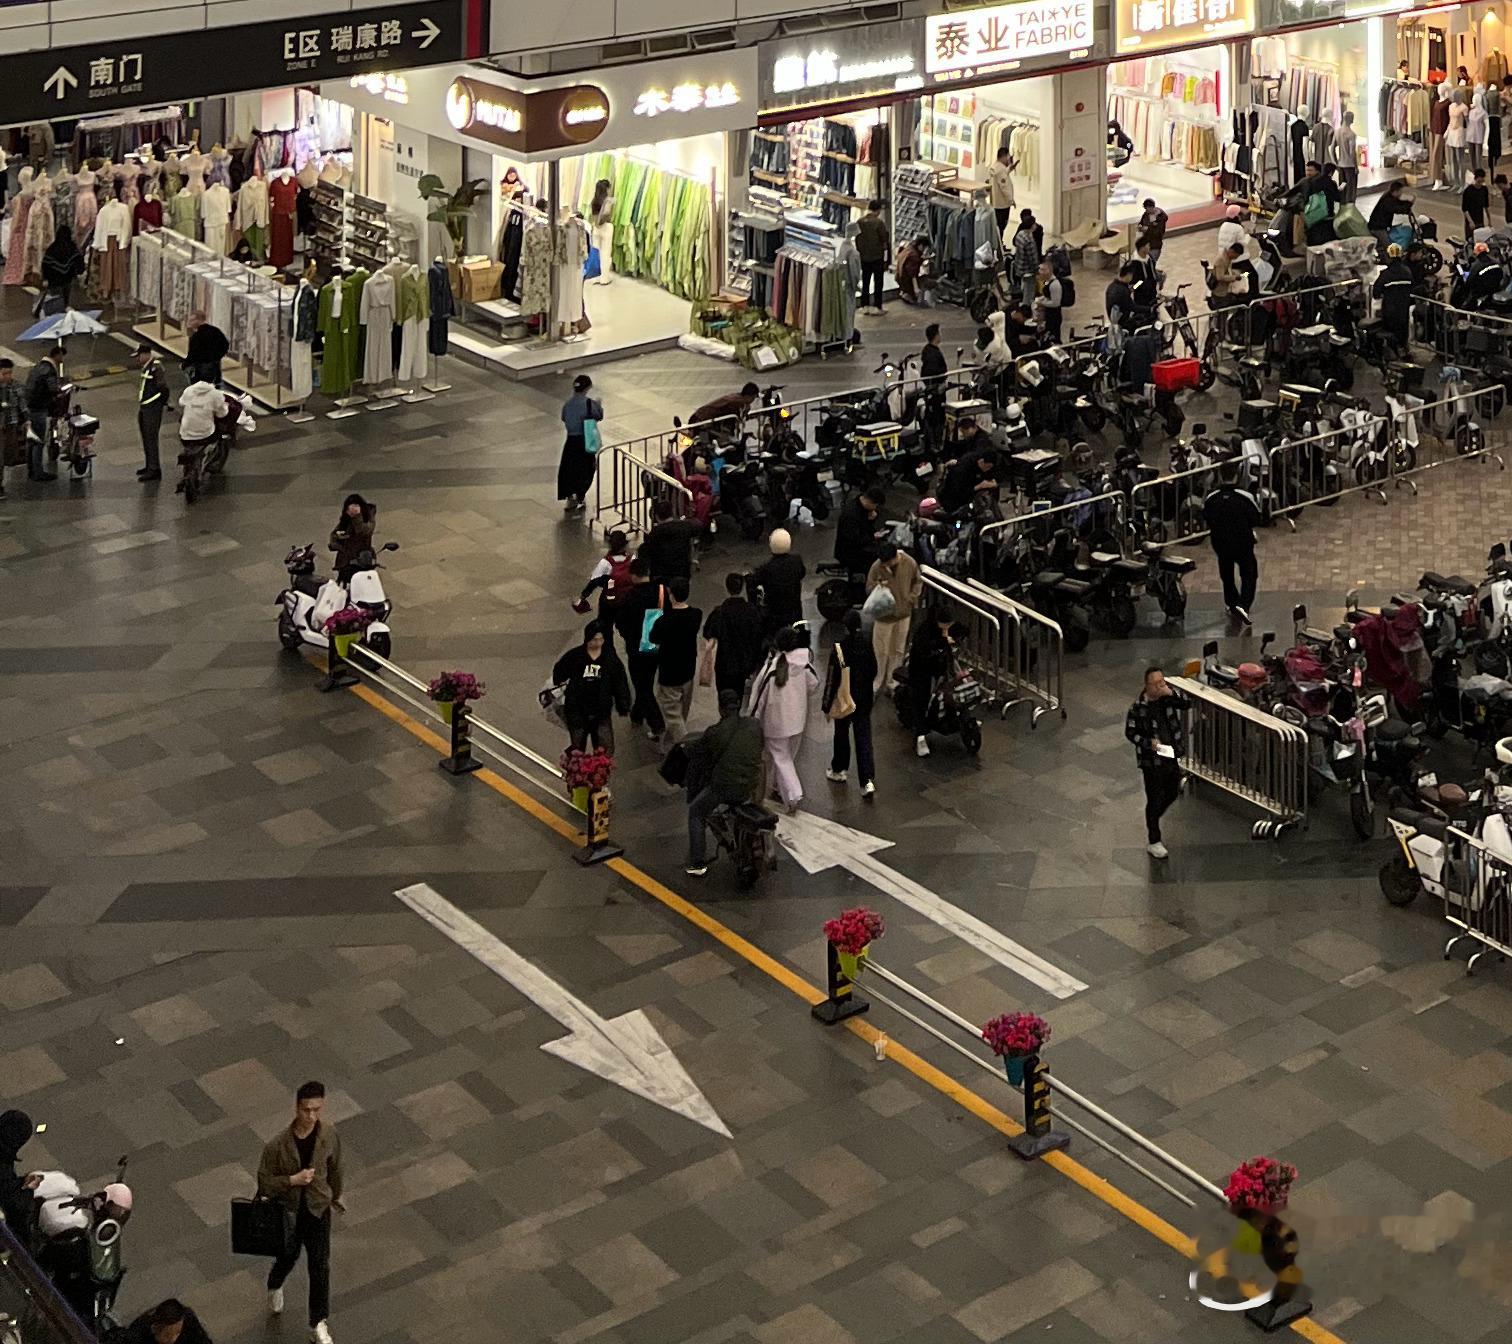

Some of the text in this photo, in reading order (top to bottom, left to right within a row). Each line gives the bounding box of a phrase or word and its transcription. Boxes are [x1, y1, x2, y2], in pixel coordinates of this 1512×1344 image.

[284, 29, 321, 60] E区
[331, 19, 402, 52] 瑞康路
[936, 15, 1010, 62] 泰业
[1015, 20, 1087, 49] FABRIC
[89, 53, 143, 87] 南门
[286, 60, 308, 71] ZONE
[88, 81, 143, 99] SOUTH GATE
